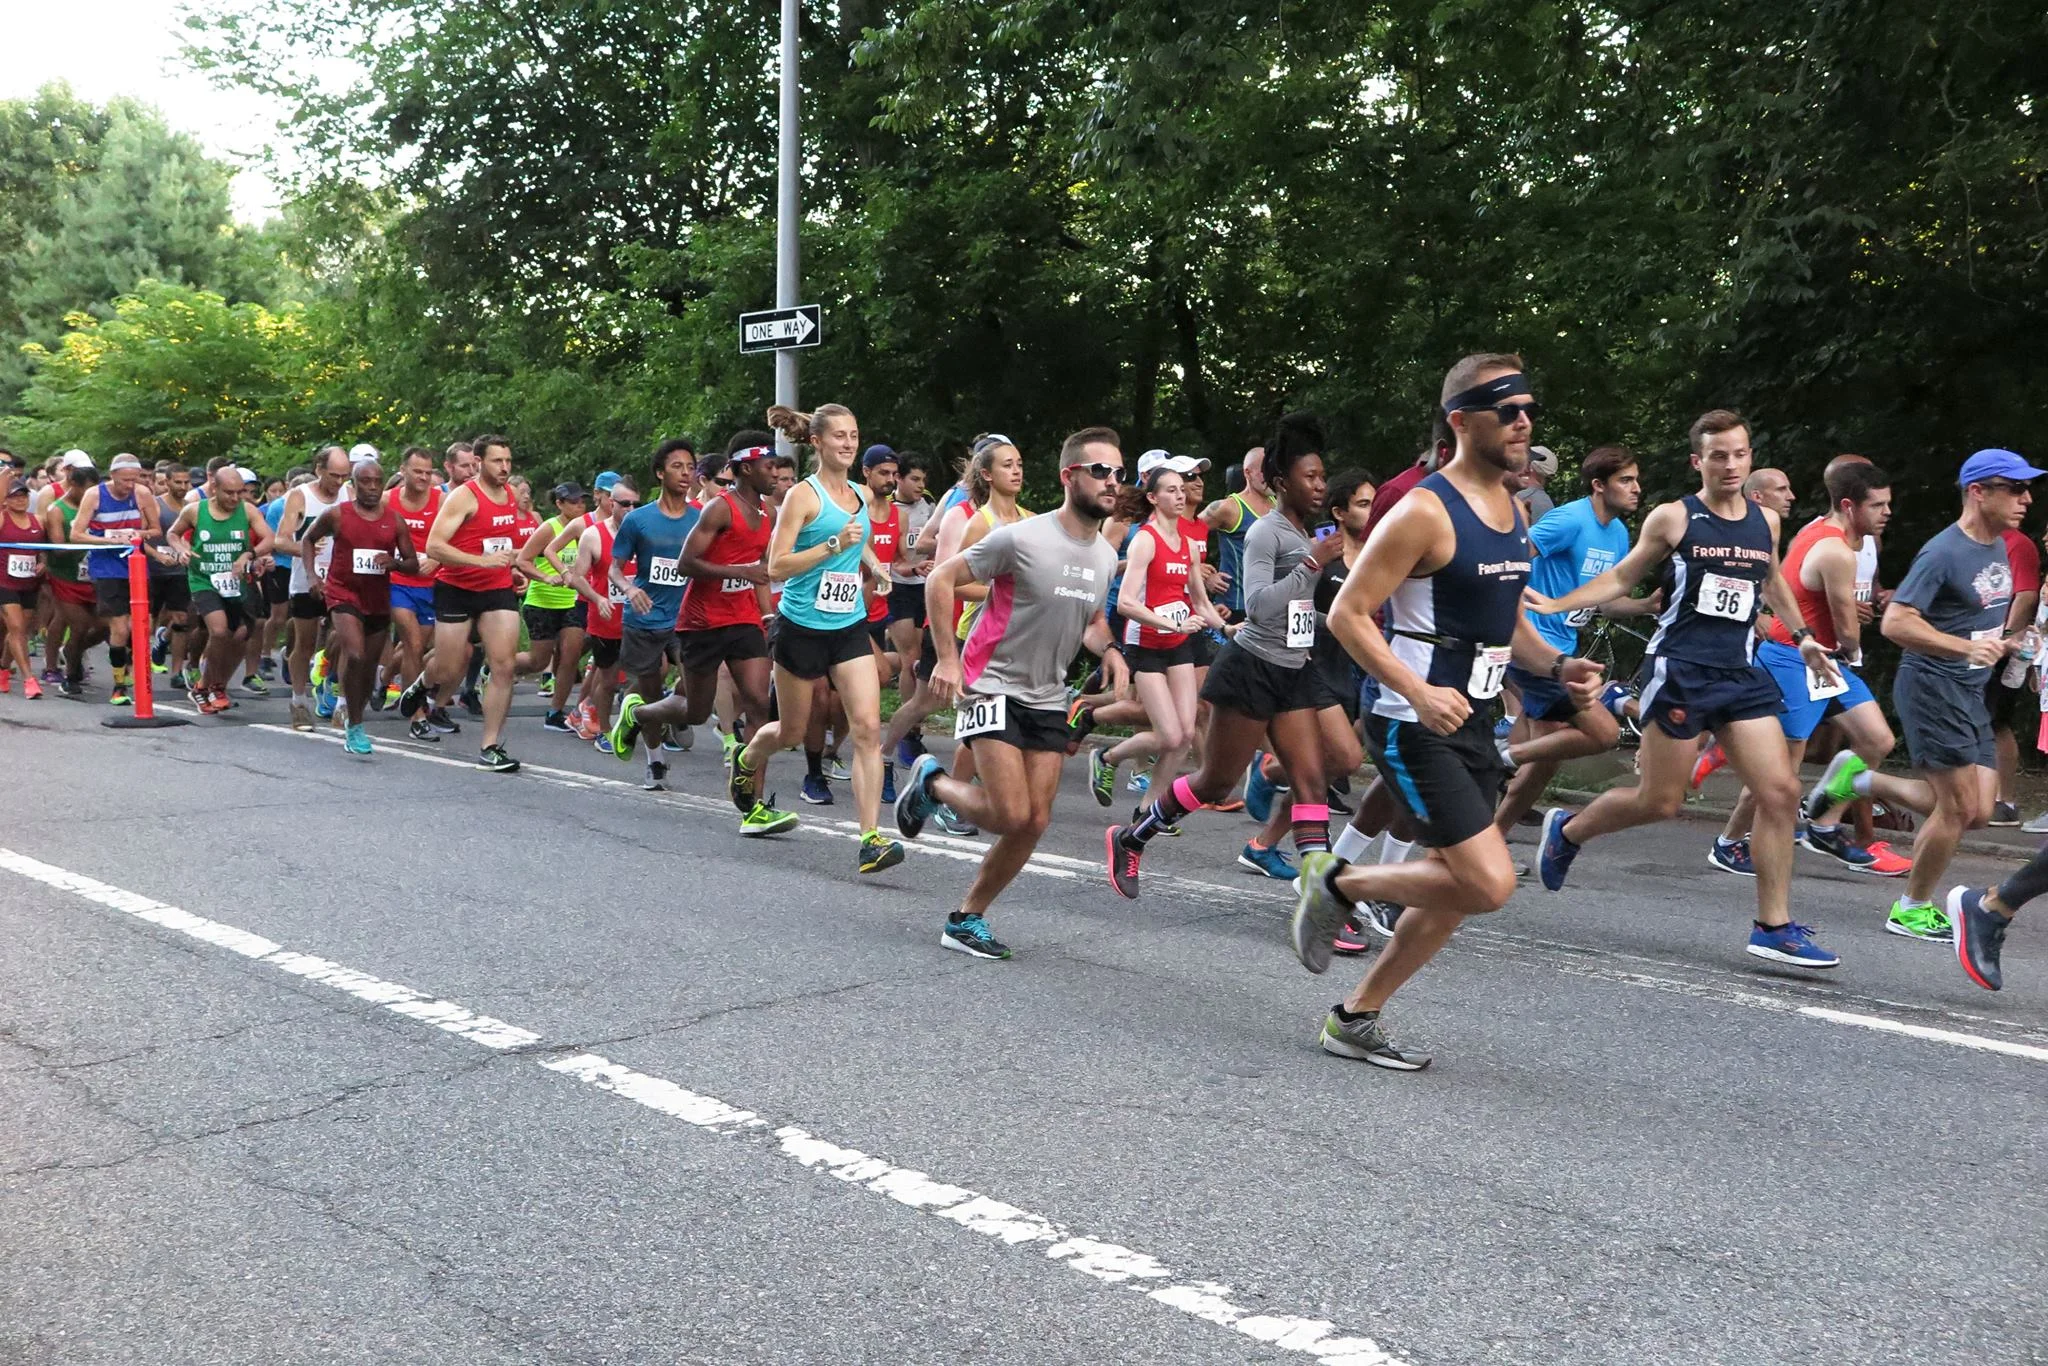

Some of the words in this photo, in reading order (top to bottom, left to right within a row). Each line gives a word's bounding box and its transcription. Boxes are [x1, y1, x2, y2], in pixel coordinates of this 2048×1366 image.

[752, 324, 773, 340] ONE
[784, 319, 807, 336] WAY
[404, 519, 425, 528] PTC
[493, 515, 514, 526] PPTC
[874, 535, 892, 544] PTC
[203, 543, 243, 553] RUNNING
[1693, 546, 1731, 557] FRONT
[1734, 546, 1770, 562] RUNNER
[214, 553, 232, 562] FOR
[1166, 562, 1188, 575] PPTC
[1478, 563, 1504, 575] FRONT
[821, 581, 857, 602] 3482
[1715, 590, 1740, 614] 96
